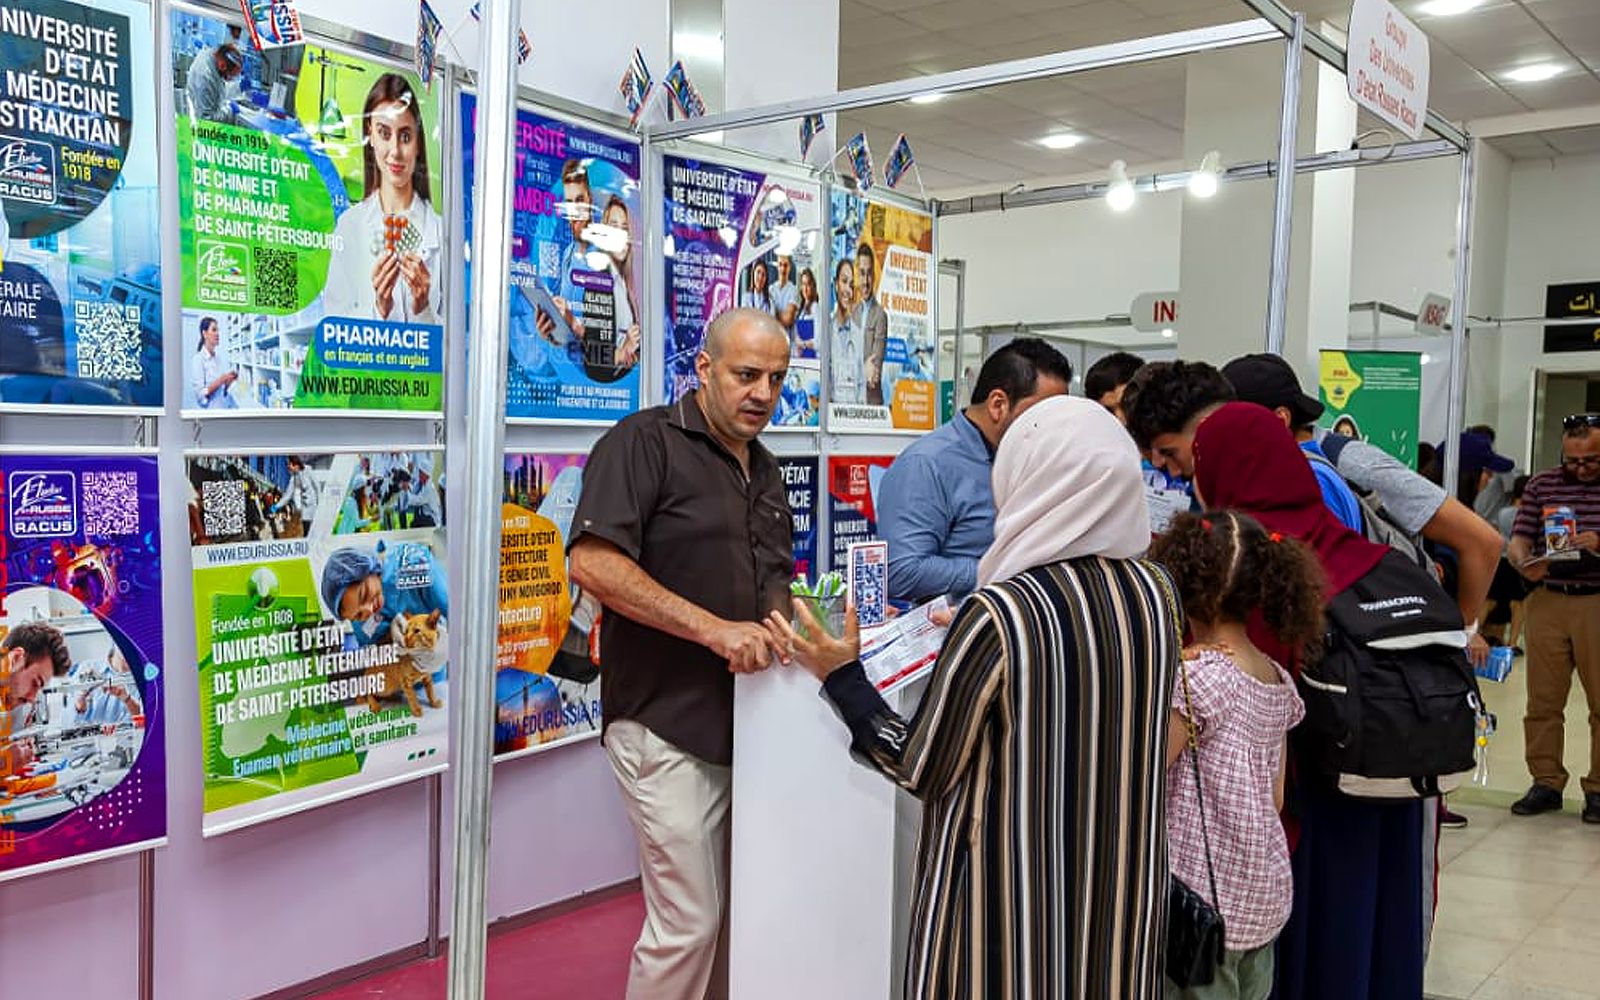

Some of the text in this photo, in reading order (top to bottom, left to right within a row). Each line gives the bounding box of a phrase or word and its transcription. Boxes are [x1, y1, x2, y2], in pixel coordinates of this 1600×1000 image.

[45, 47, 119, 86] D'ÉTAT
[7, 69, 120, 117] MÉDECINE
[0, 100, 120, 146] STRAKHAN
[230, 135, 243, 146] en
[61, 146, 120, 170] Fondée en
[192, 140, 311, 181] UNIVERSITÉ D'ÉTAT
[61, 163, 92, 182] 1918
[193, 166, 278, 198] DE CHIMIE ET
[672, 164, 727, 192] UNIVERSITÉ
[194, 190, 291, 223] DE PHARMACIE
[672, 186, 736, 212] DE MÉDECINE
[672, 205, 685, 223] DE
[195, 214, 345, 251] DE SAINT-PÉTERSBOURG
[200, 287, 248, 302] RACUS
[1153, 299, 1178, 323] IN
[322, 322, 431, 351] PHARMACIE
[323, 346, 430, 370] en français et en anglais
[301, 375, 430, 398] WWW.EDURUSSIA.RU
[14, 519, 73, 533] RACUS
[206, 540, 310, 564] WWW.EDURUSSIA.RU
[211, 615, 251, 637] Fondée
[252, 615, 266, 630] en
[211, 620, 346, 665] UNIVERSITÉ D'ÉTAT
[214, 644, 400, 696] DE MÉDECINE VÉTÉRINAIRE
[215, 671, 386, 726] DE SAINT-PÉTERSBOURG
[283, 738, 351, 765] vétérinaire
[353, 736, 366, 750] et
[368, 722, 418, 747] sanitaire
